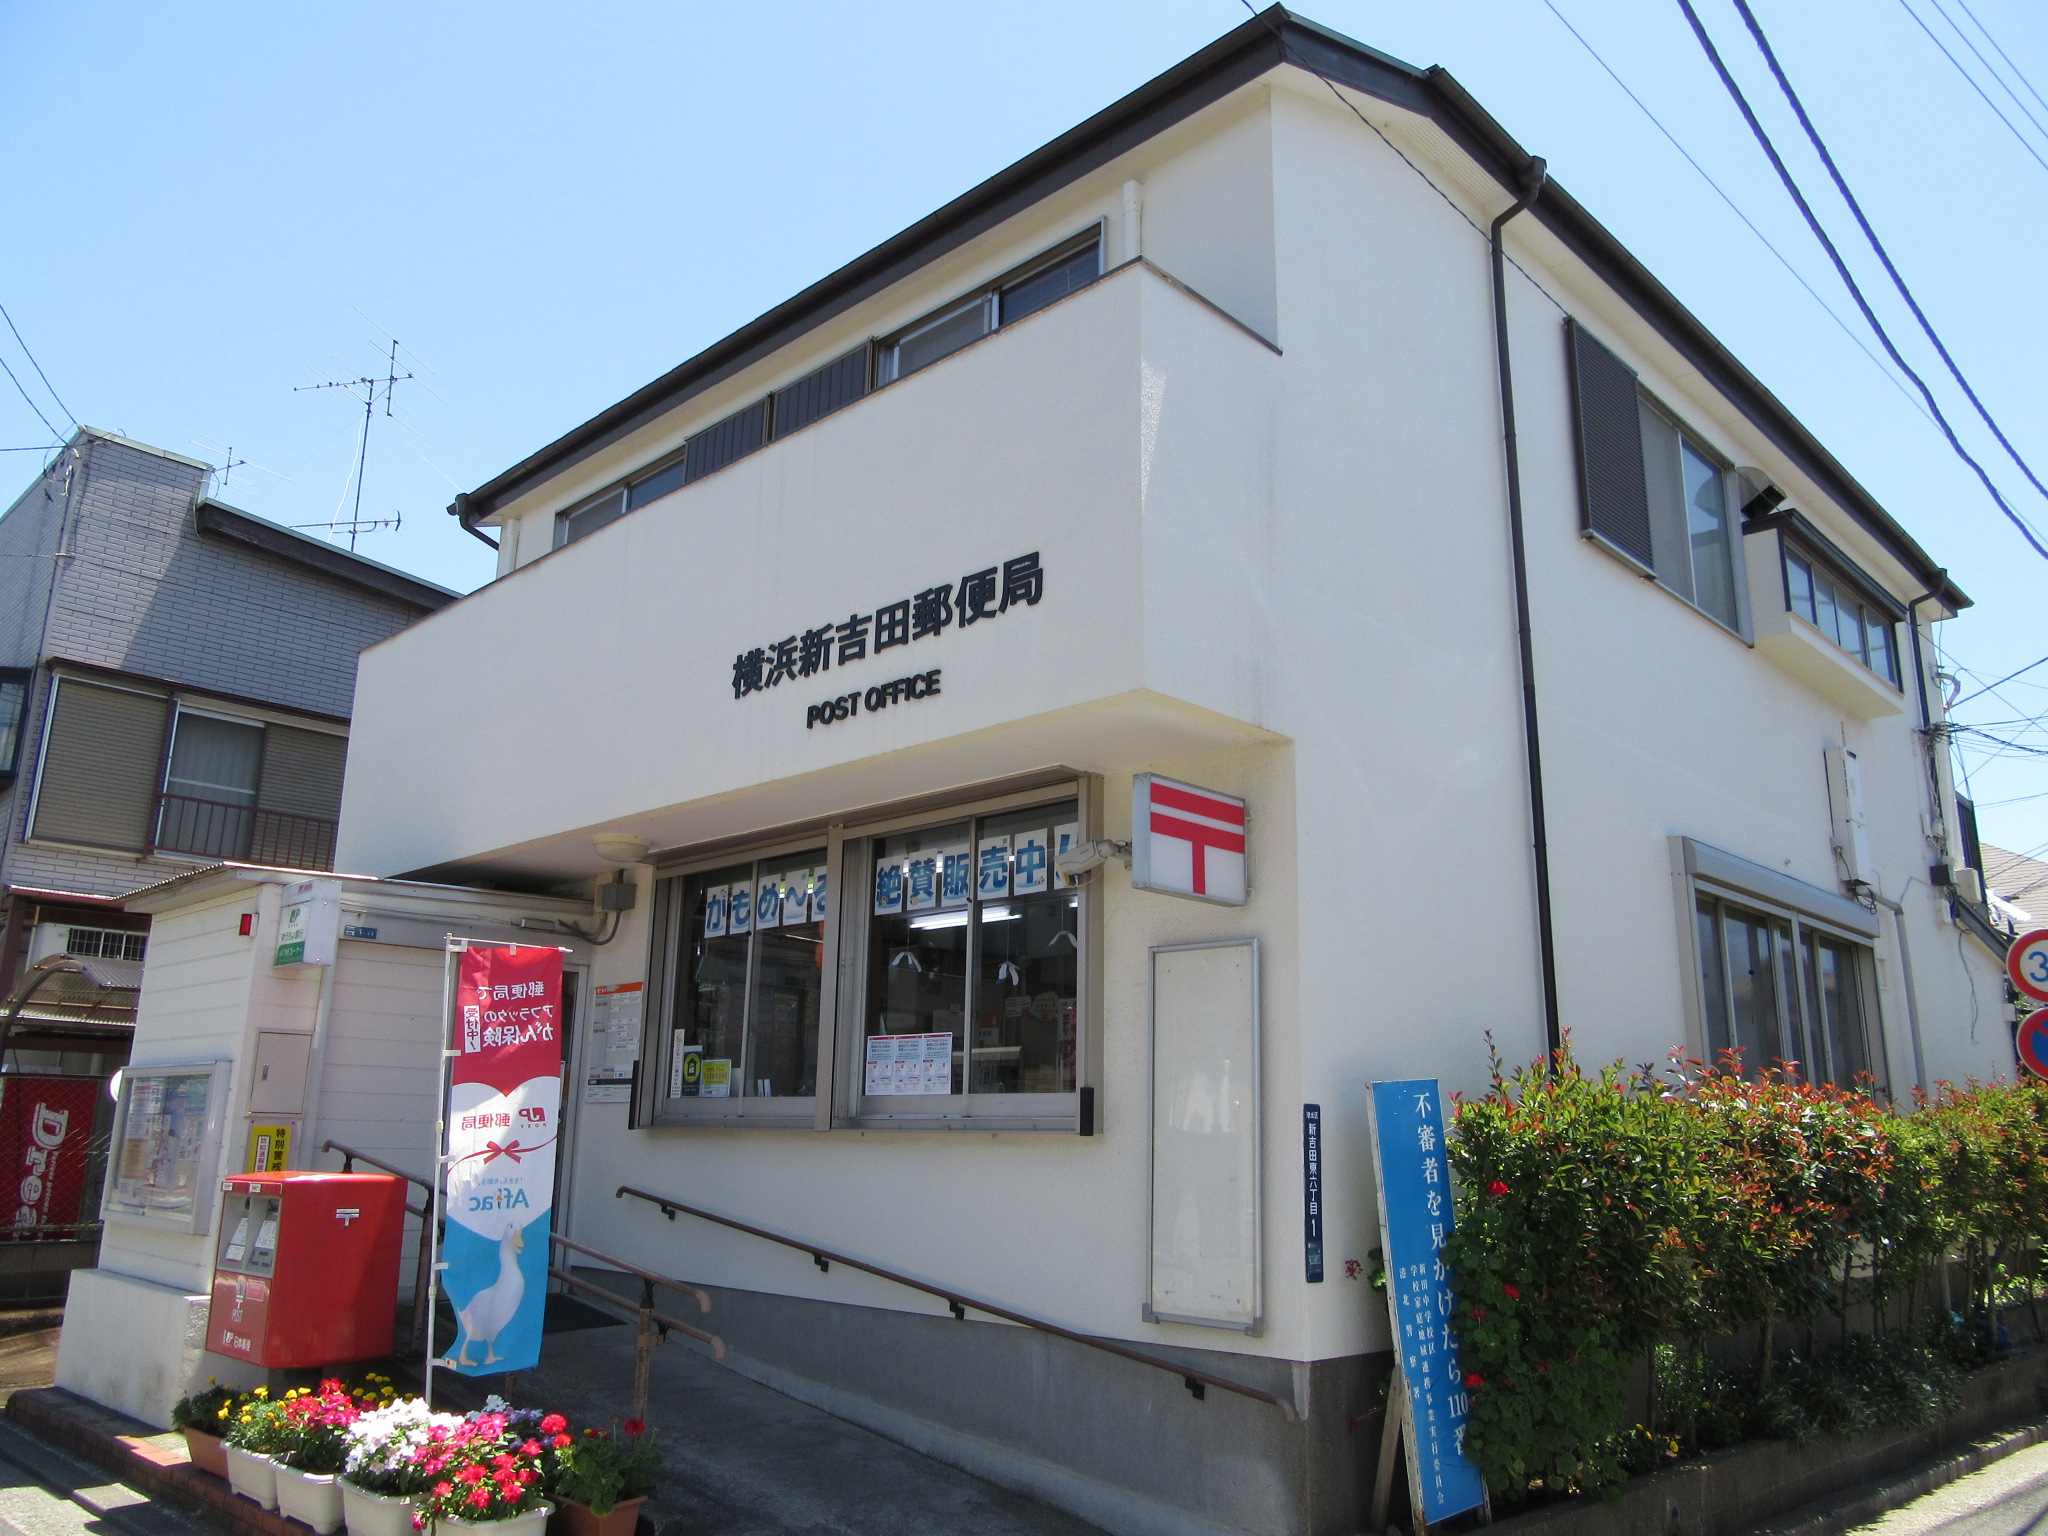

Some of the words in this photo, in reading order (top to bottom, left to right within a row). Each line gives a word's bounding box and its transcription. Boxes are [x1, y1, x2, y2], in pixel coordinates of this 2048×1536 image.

[731, 551, 1044, 699] 横浜新吉田郵便局
[806, 691, 862, 729] POST
[864, 669, 942, 712] OFFICE
[271, 1128, 286, 1171] 特別警戒
[1308, 1123, 1318, 1215] 新吉田東六丁目
